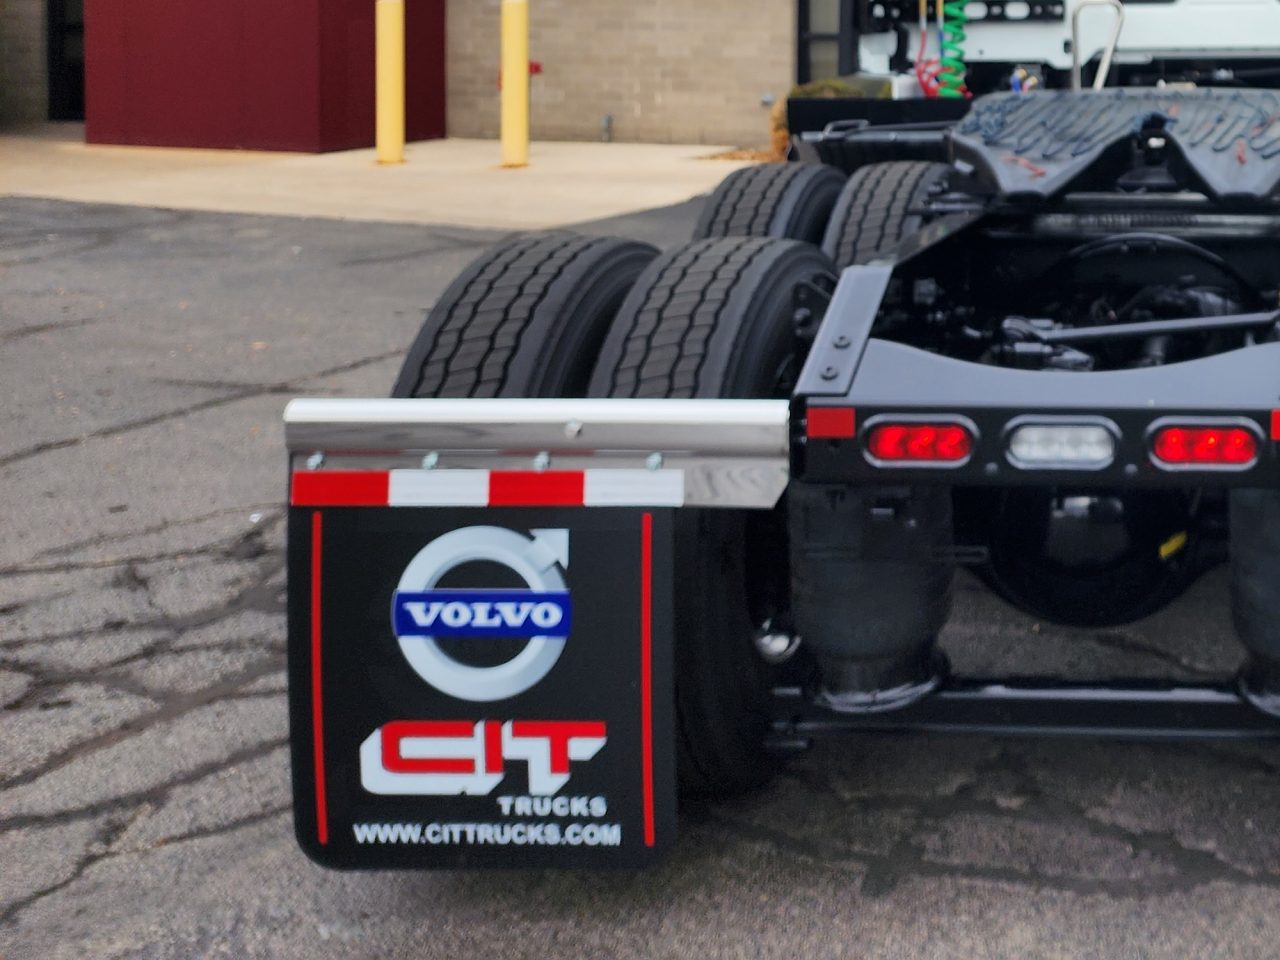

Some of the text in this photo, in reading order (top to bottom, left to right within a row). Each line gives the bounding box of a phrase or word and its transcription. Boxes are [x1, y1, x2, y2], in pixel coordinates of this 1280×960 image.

[403, 602, 563, 628] VOLVO
[359, 719, 607, 796] CIT
[497, 795, 607, 817] TRUCKS
[353, 823, 622, 846] WWW.CITTRUCKS.COM
